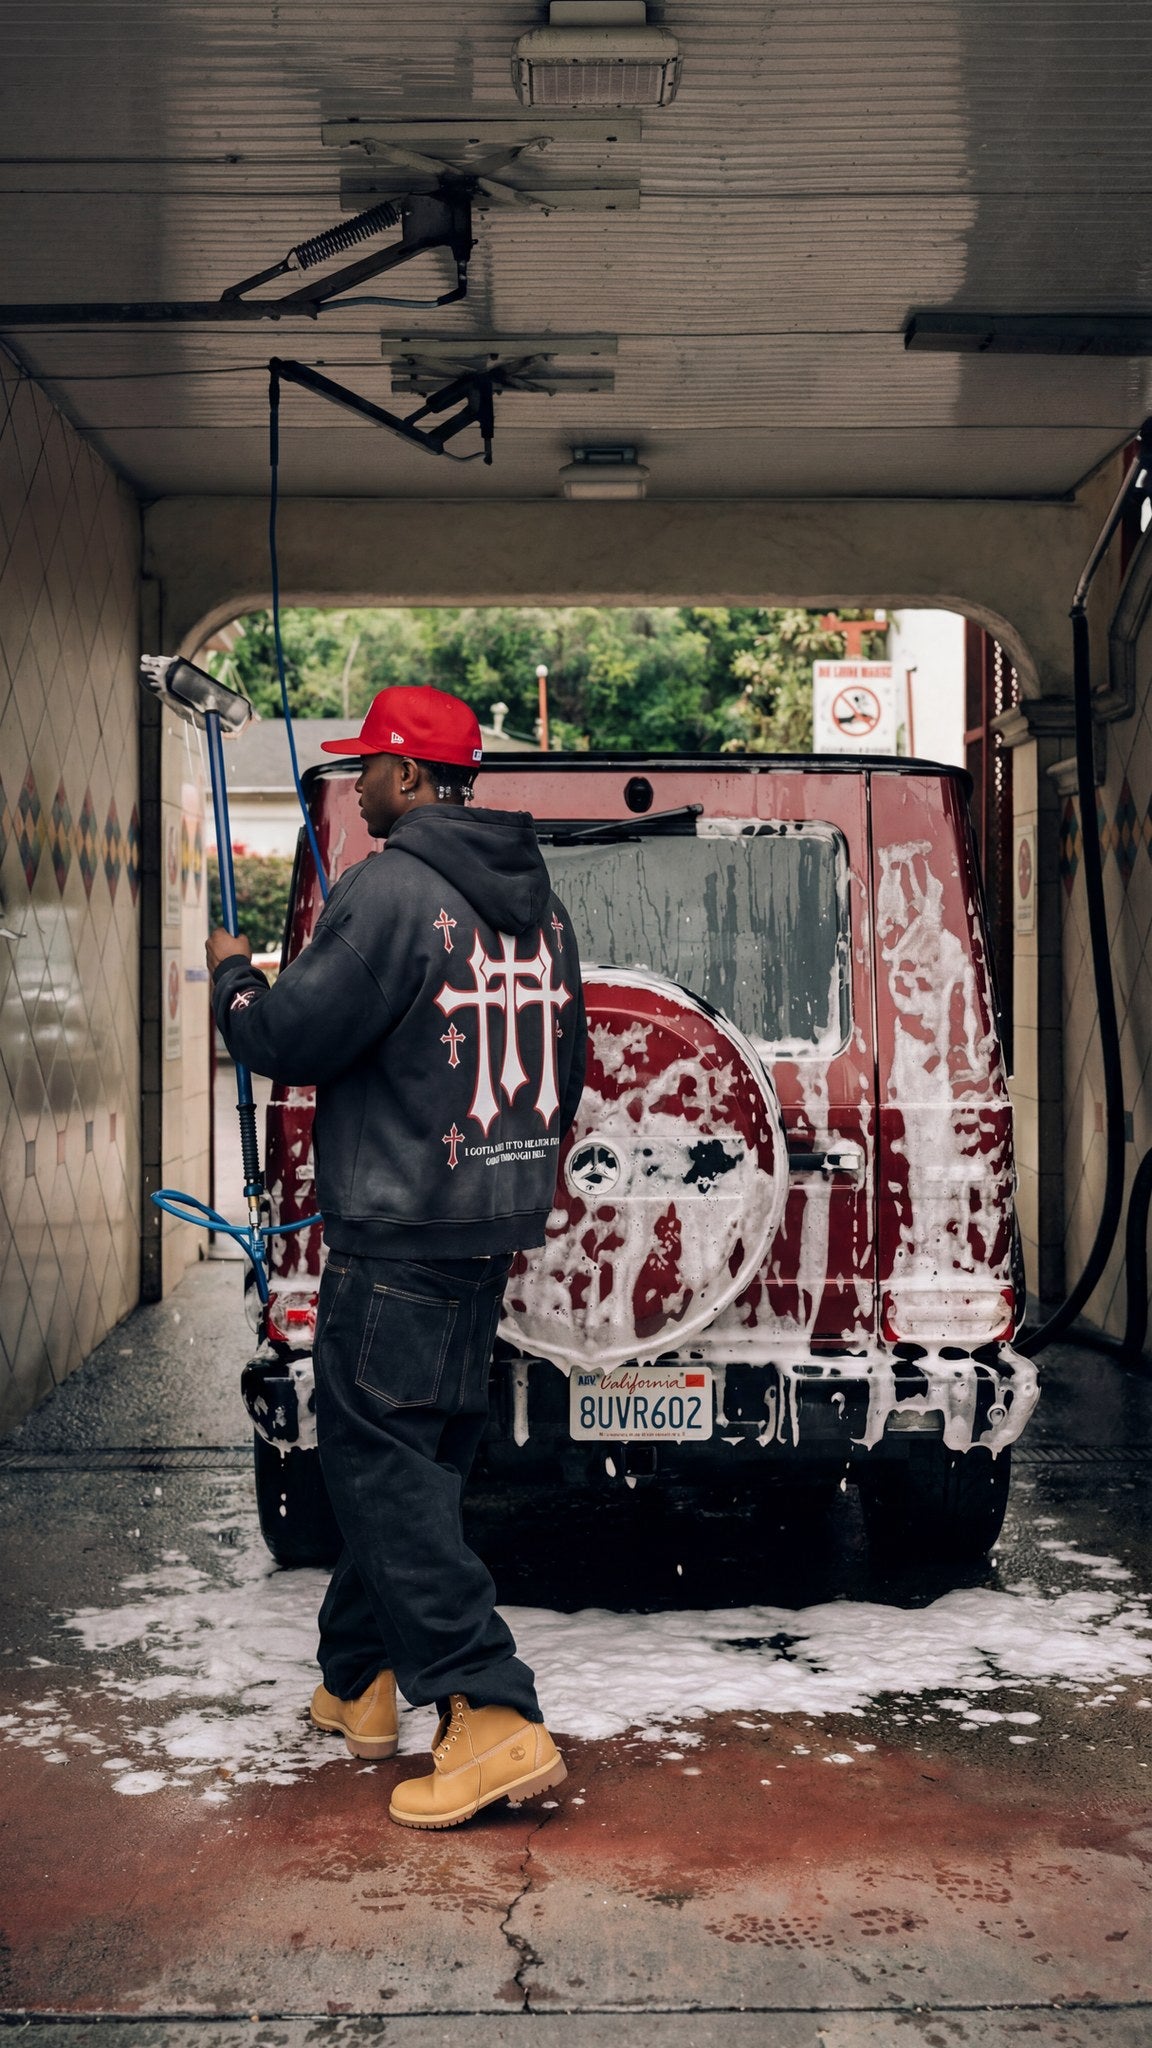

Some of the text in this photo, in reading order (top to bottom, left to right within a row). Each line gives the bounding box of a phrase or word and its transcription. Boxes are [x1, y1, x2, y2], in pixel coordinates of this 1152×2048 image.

[513, 1141, 523, 1149] TO
[601, 1372, 685, 1394] California
[581, 1396, 702, 1429] 8UVR602
